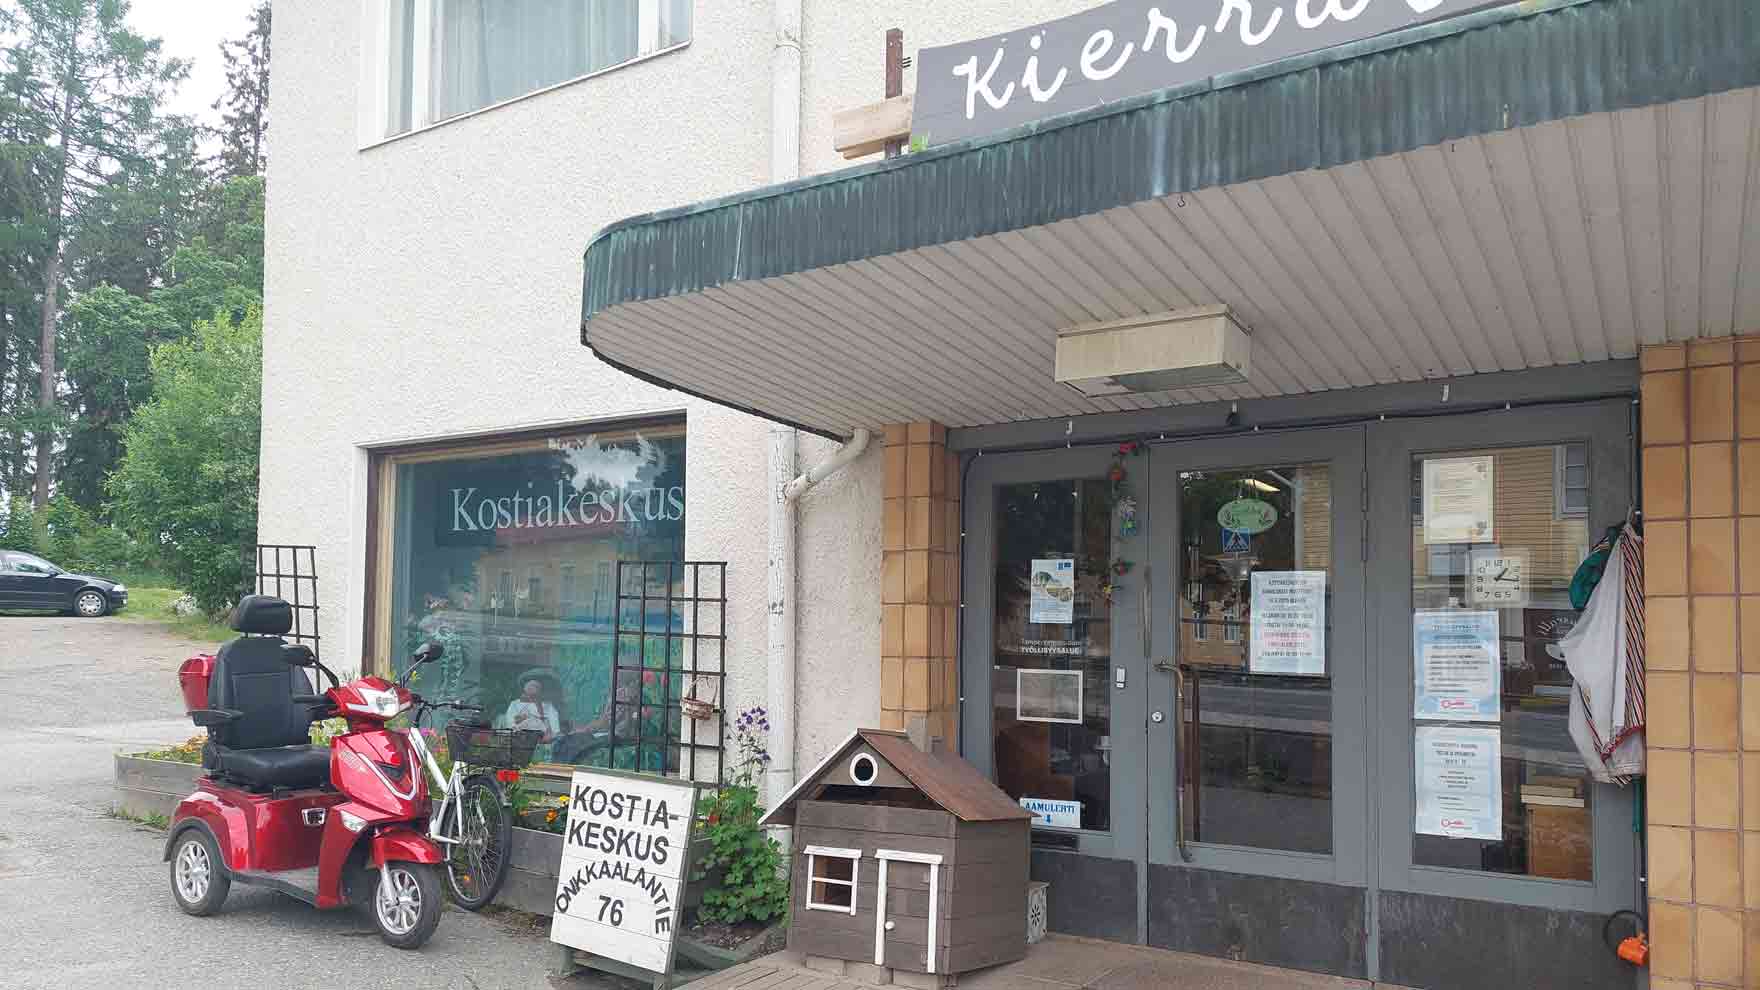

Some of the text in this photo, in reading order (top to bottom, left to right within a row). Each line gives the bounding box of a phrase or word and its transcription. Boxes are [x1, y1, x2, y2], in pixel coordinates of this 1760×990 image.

[450, 479, 685, 531] Kostiakeskus
[572, 785, 679, 829] KOSTIA-
[1025, 801, 1075, 815] AAMULEHTI
[568, 818, 669, 865] KESKUS
[555, 860, 671, 934] ONKKAALANTIE
[598, 895, 624, 926] 76
